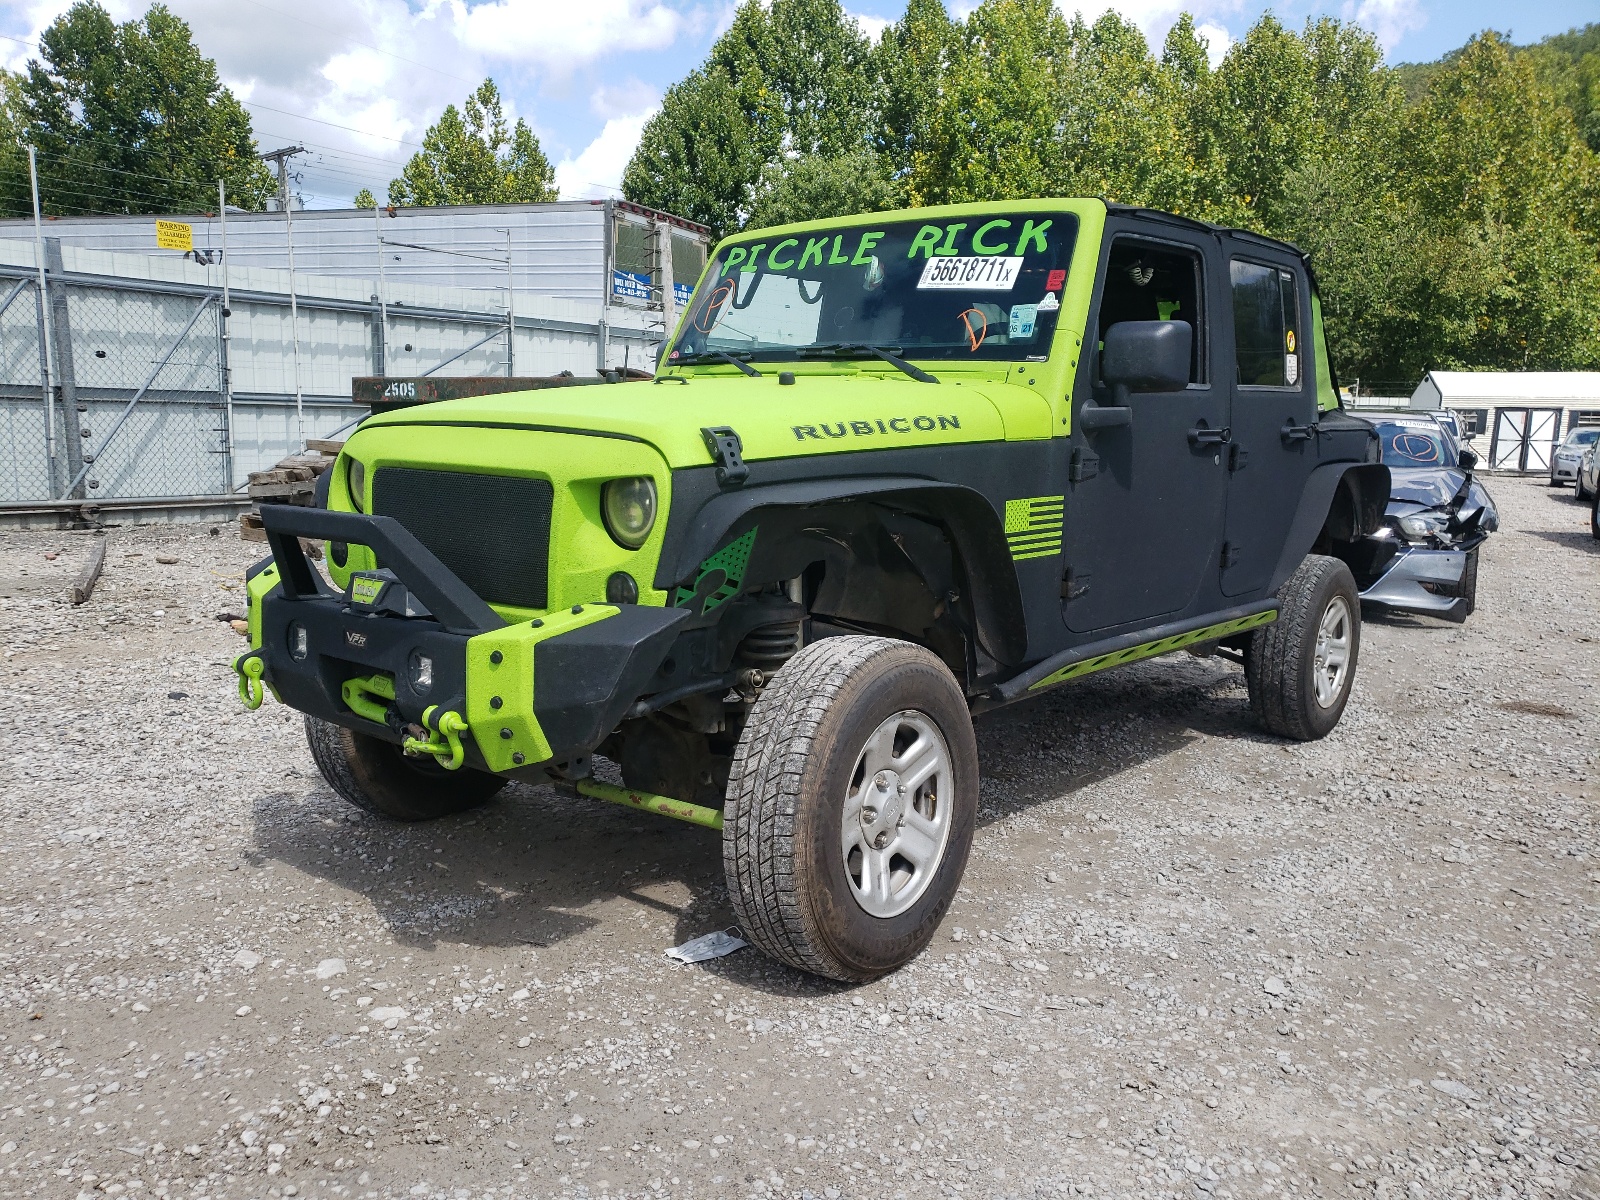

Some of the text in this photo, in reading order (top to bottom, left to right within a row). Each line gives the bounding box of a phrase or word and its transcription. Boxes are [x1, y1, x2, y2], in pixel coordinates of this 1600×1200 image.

[158, 221, 190, 232] WARNING
[720, 231, 885, 277] PICKLE
[908, 219, 1053, 259] RICK
[1022, 324, 1032, 333] 21
[384, 381, 415, 397] 2505
[790, 413, 962, 442] RUBICON
